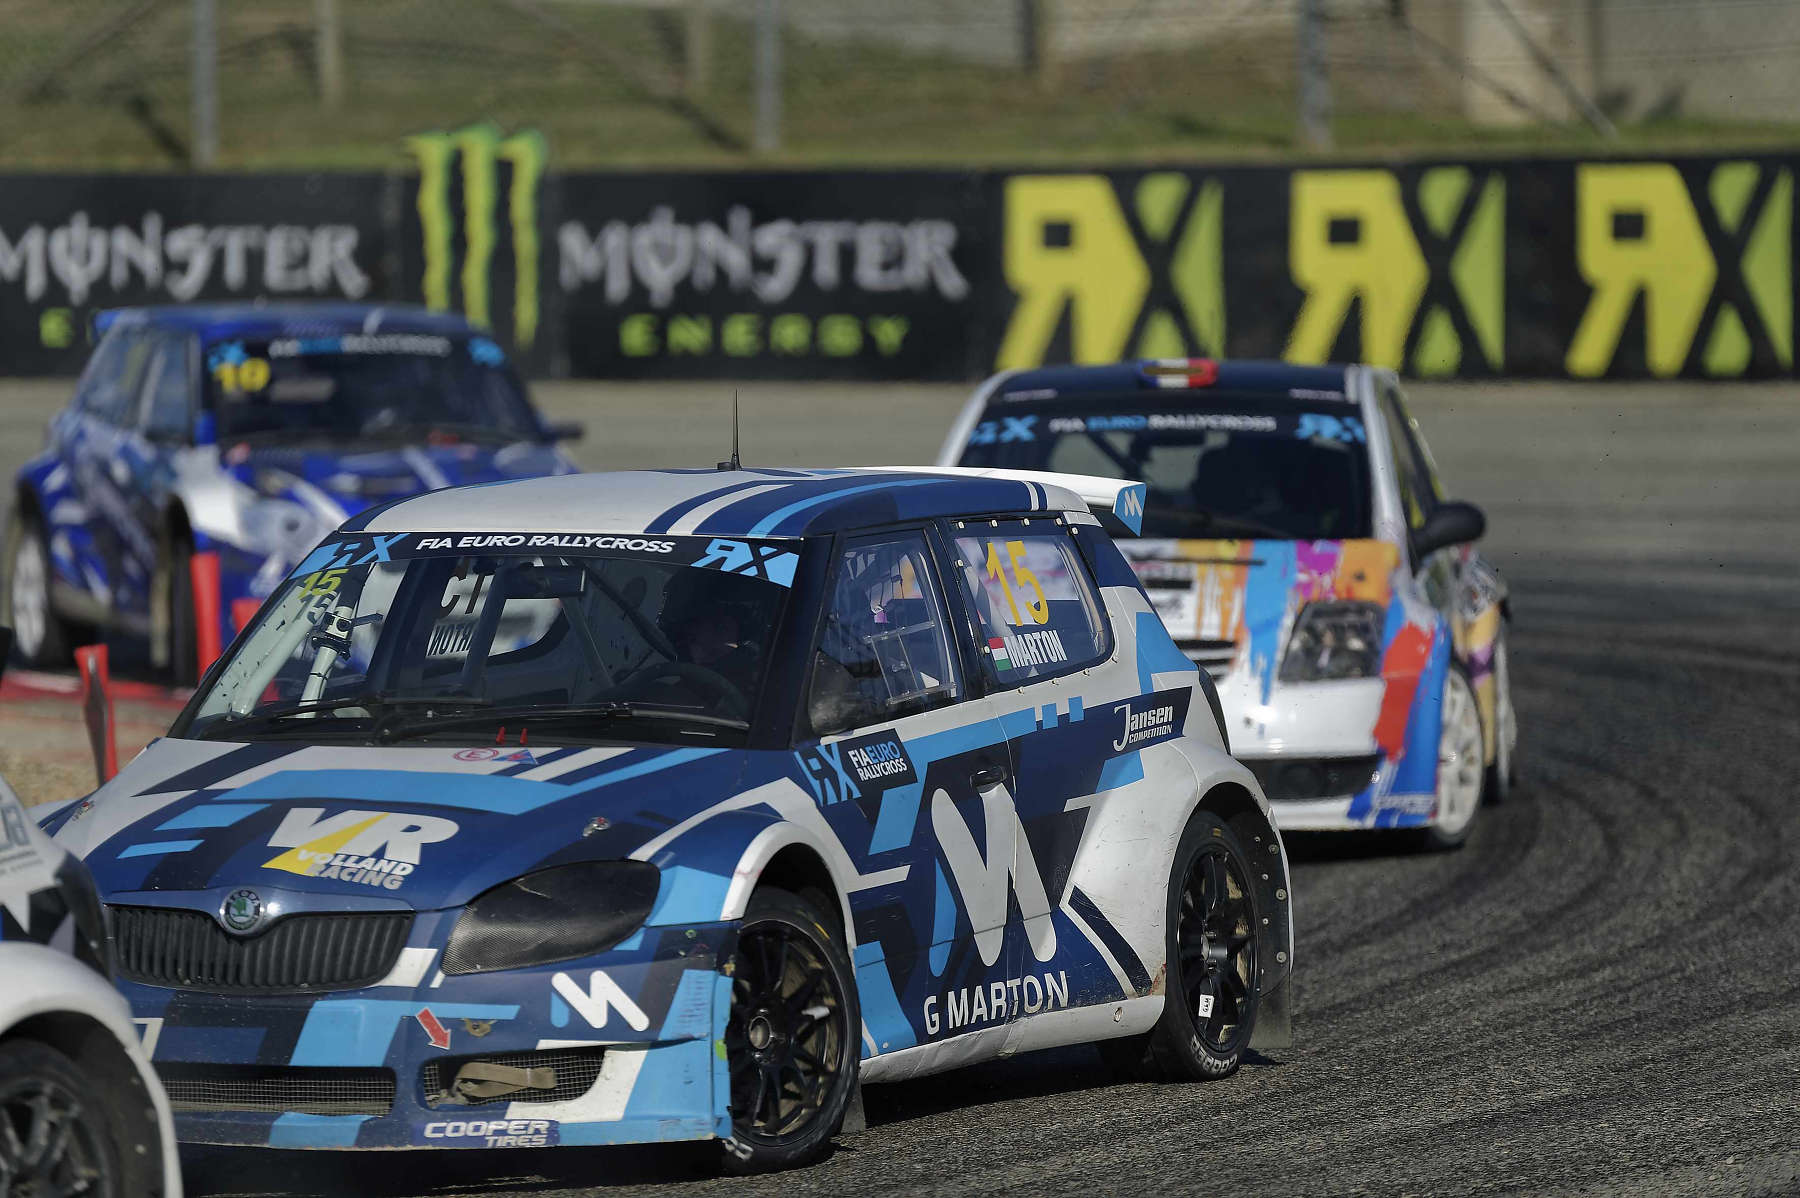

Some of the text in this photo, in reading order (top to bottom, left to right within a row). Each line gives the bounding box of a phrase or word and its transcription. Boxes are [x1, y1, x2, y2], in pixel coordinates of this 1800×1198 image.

[557, 205, 970, 307] MONSTER
[618, 313, 910, 357] ENERGY
[416, 535, 676, 554] FIA EURO RALLYCROSS
[299, 568, 349, 600] 15
[986, 540, 1049, 627] 15
[1003, 629, 1068, 669] MARTON
[1113, 703, 1174, 752] Jansen
[1128, 724, 1173, 744] COMPETITION
[856, 757, 908, 782] RALLYCROSS
[297, 850, 414, 877] VOLLAND
[305, 864, 406, 890] RACING
[923, 970, 1069, 1036] G MARTON
[424, 1120, 550, 1139] COOPER
[484, 1134, 548, 1149] TIRES
